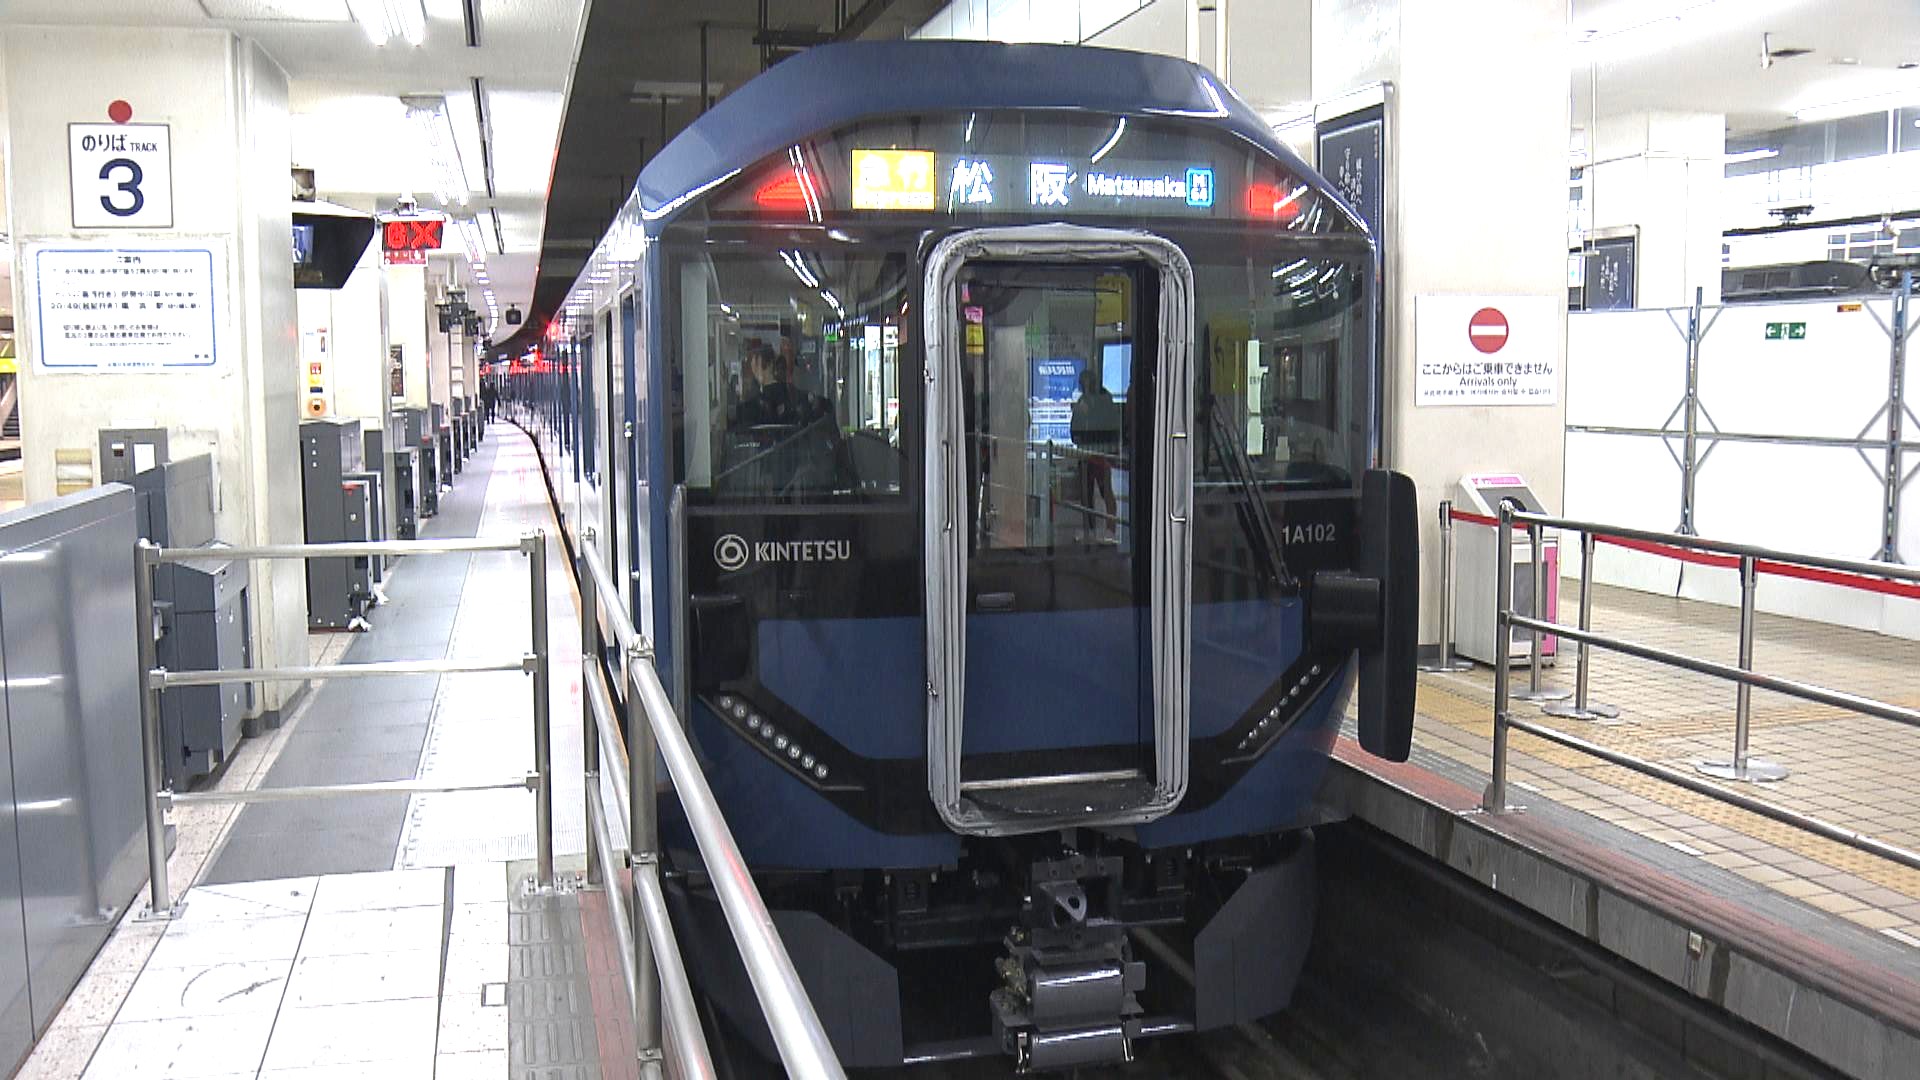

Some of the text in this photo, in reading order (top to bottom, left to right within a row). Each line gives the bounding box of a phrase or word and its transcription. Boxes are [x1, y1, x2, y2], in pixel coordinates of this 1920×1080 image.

[82, 134, 157, 152] のりば TRACK
[99, 158, 144, 216] 3
[1087, 173, 1187, 198] Matsusaka
[1422, 361, 1553, 375] ここからはご乗車できません
[1459, 376, 1518, 388] Arrivals only
[1282, 523, 1336, 545] 1A102
[755, 540, 850, 562] KINTETSU
